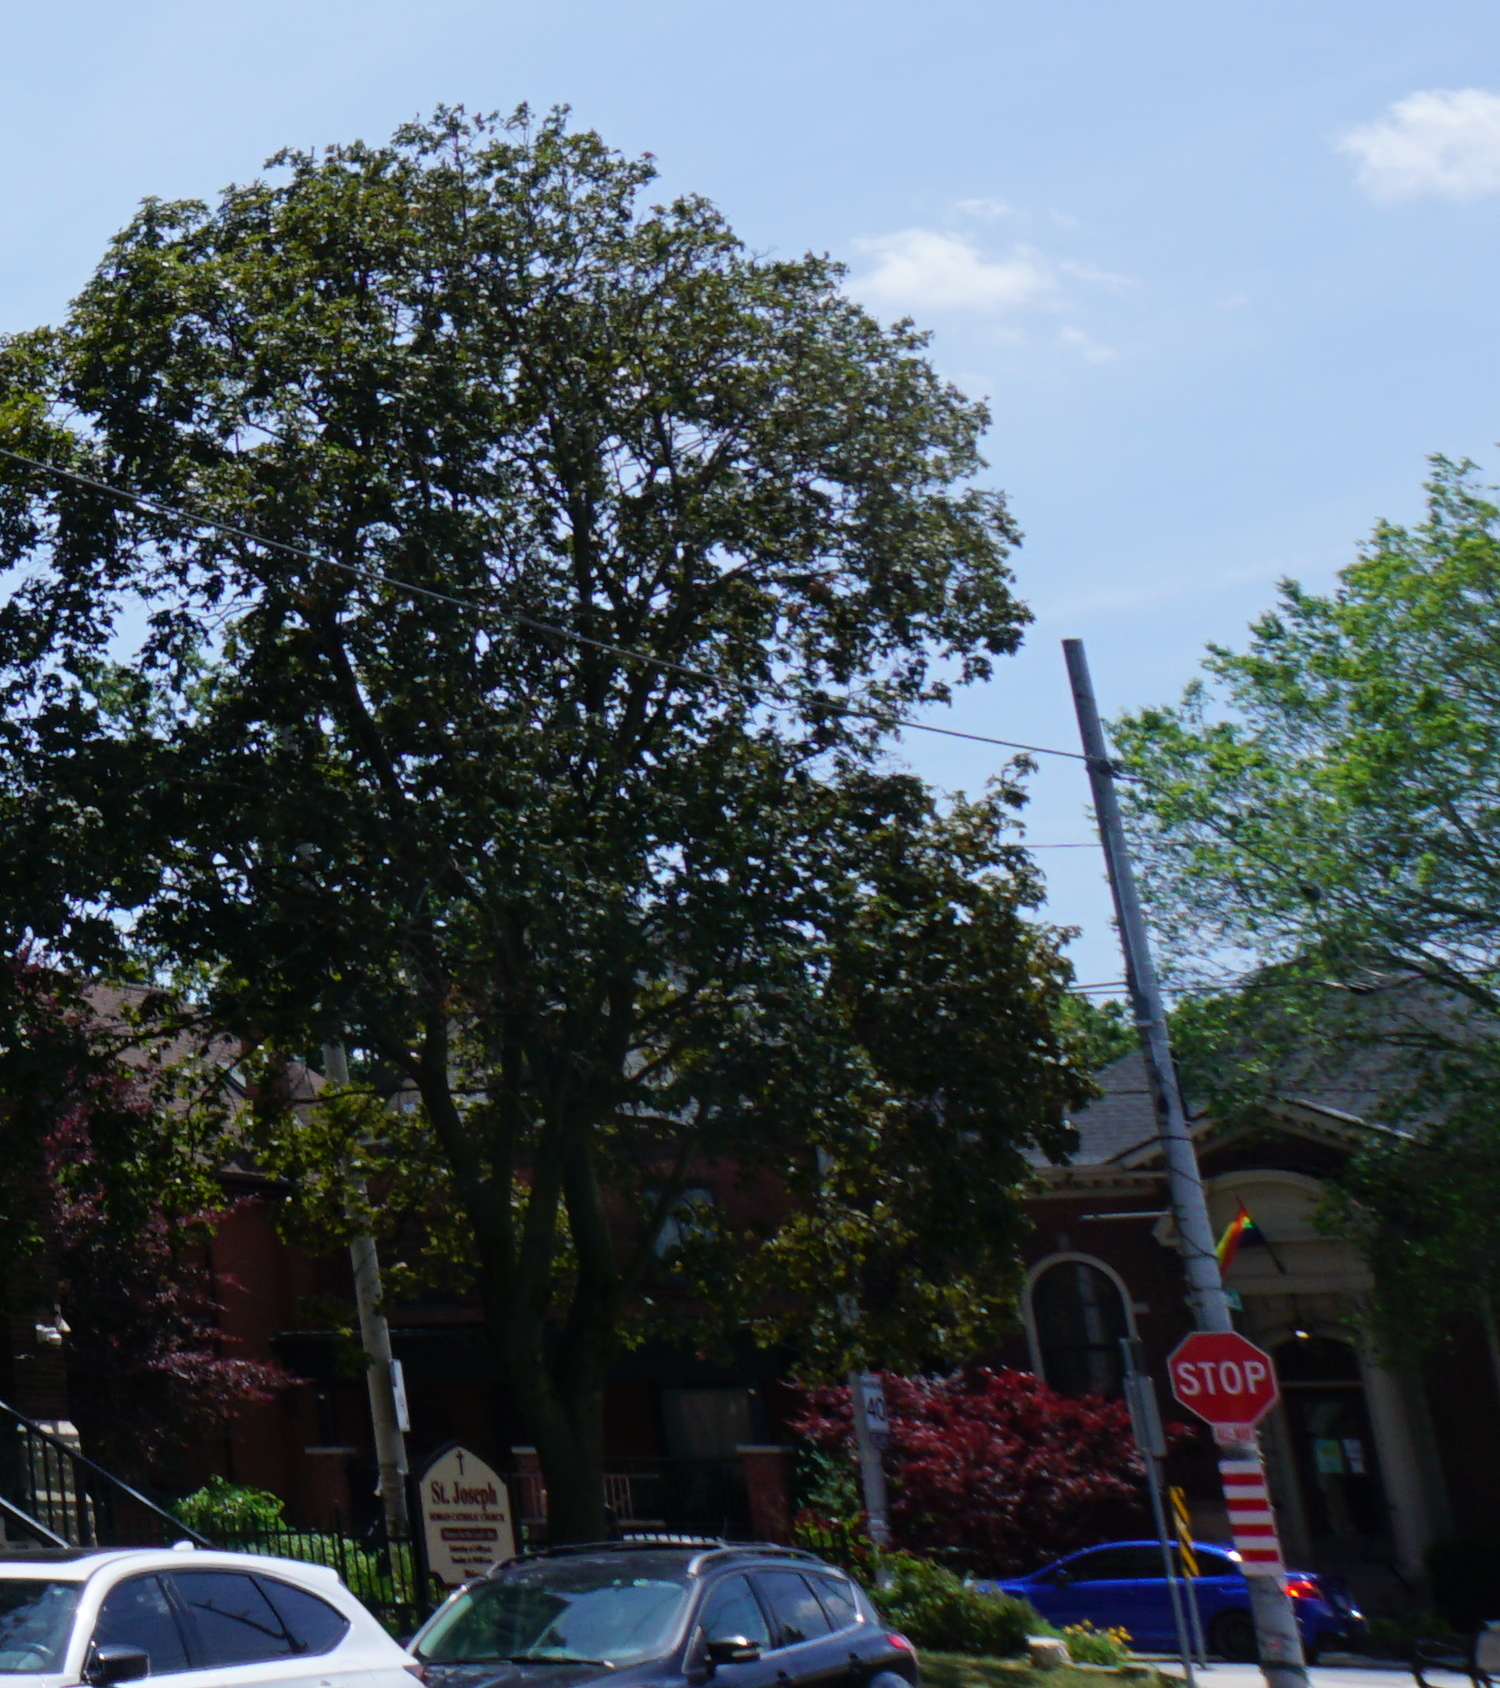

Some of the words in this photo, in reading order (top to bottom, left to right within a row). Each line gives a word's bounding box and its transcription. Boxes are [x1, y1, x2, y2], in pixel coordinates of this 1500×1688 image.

[1177, 1361, 1266, 1396] STOP
[867, 1397, 886, 1421] 40
[430, 1480, 450, 1504] St.
[453, 1481, 498, 1512] Joseph
